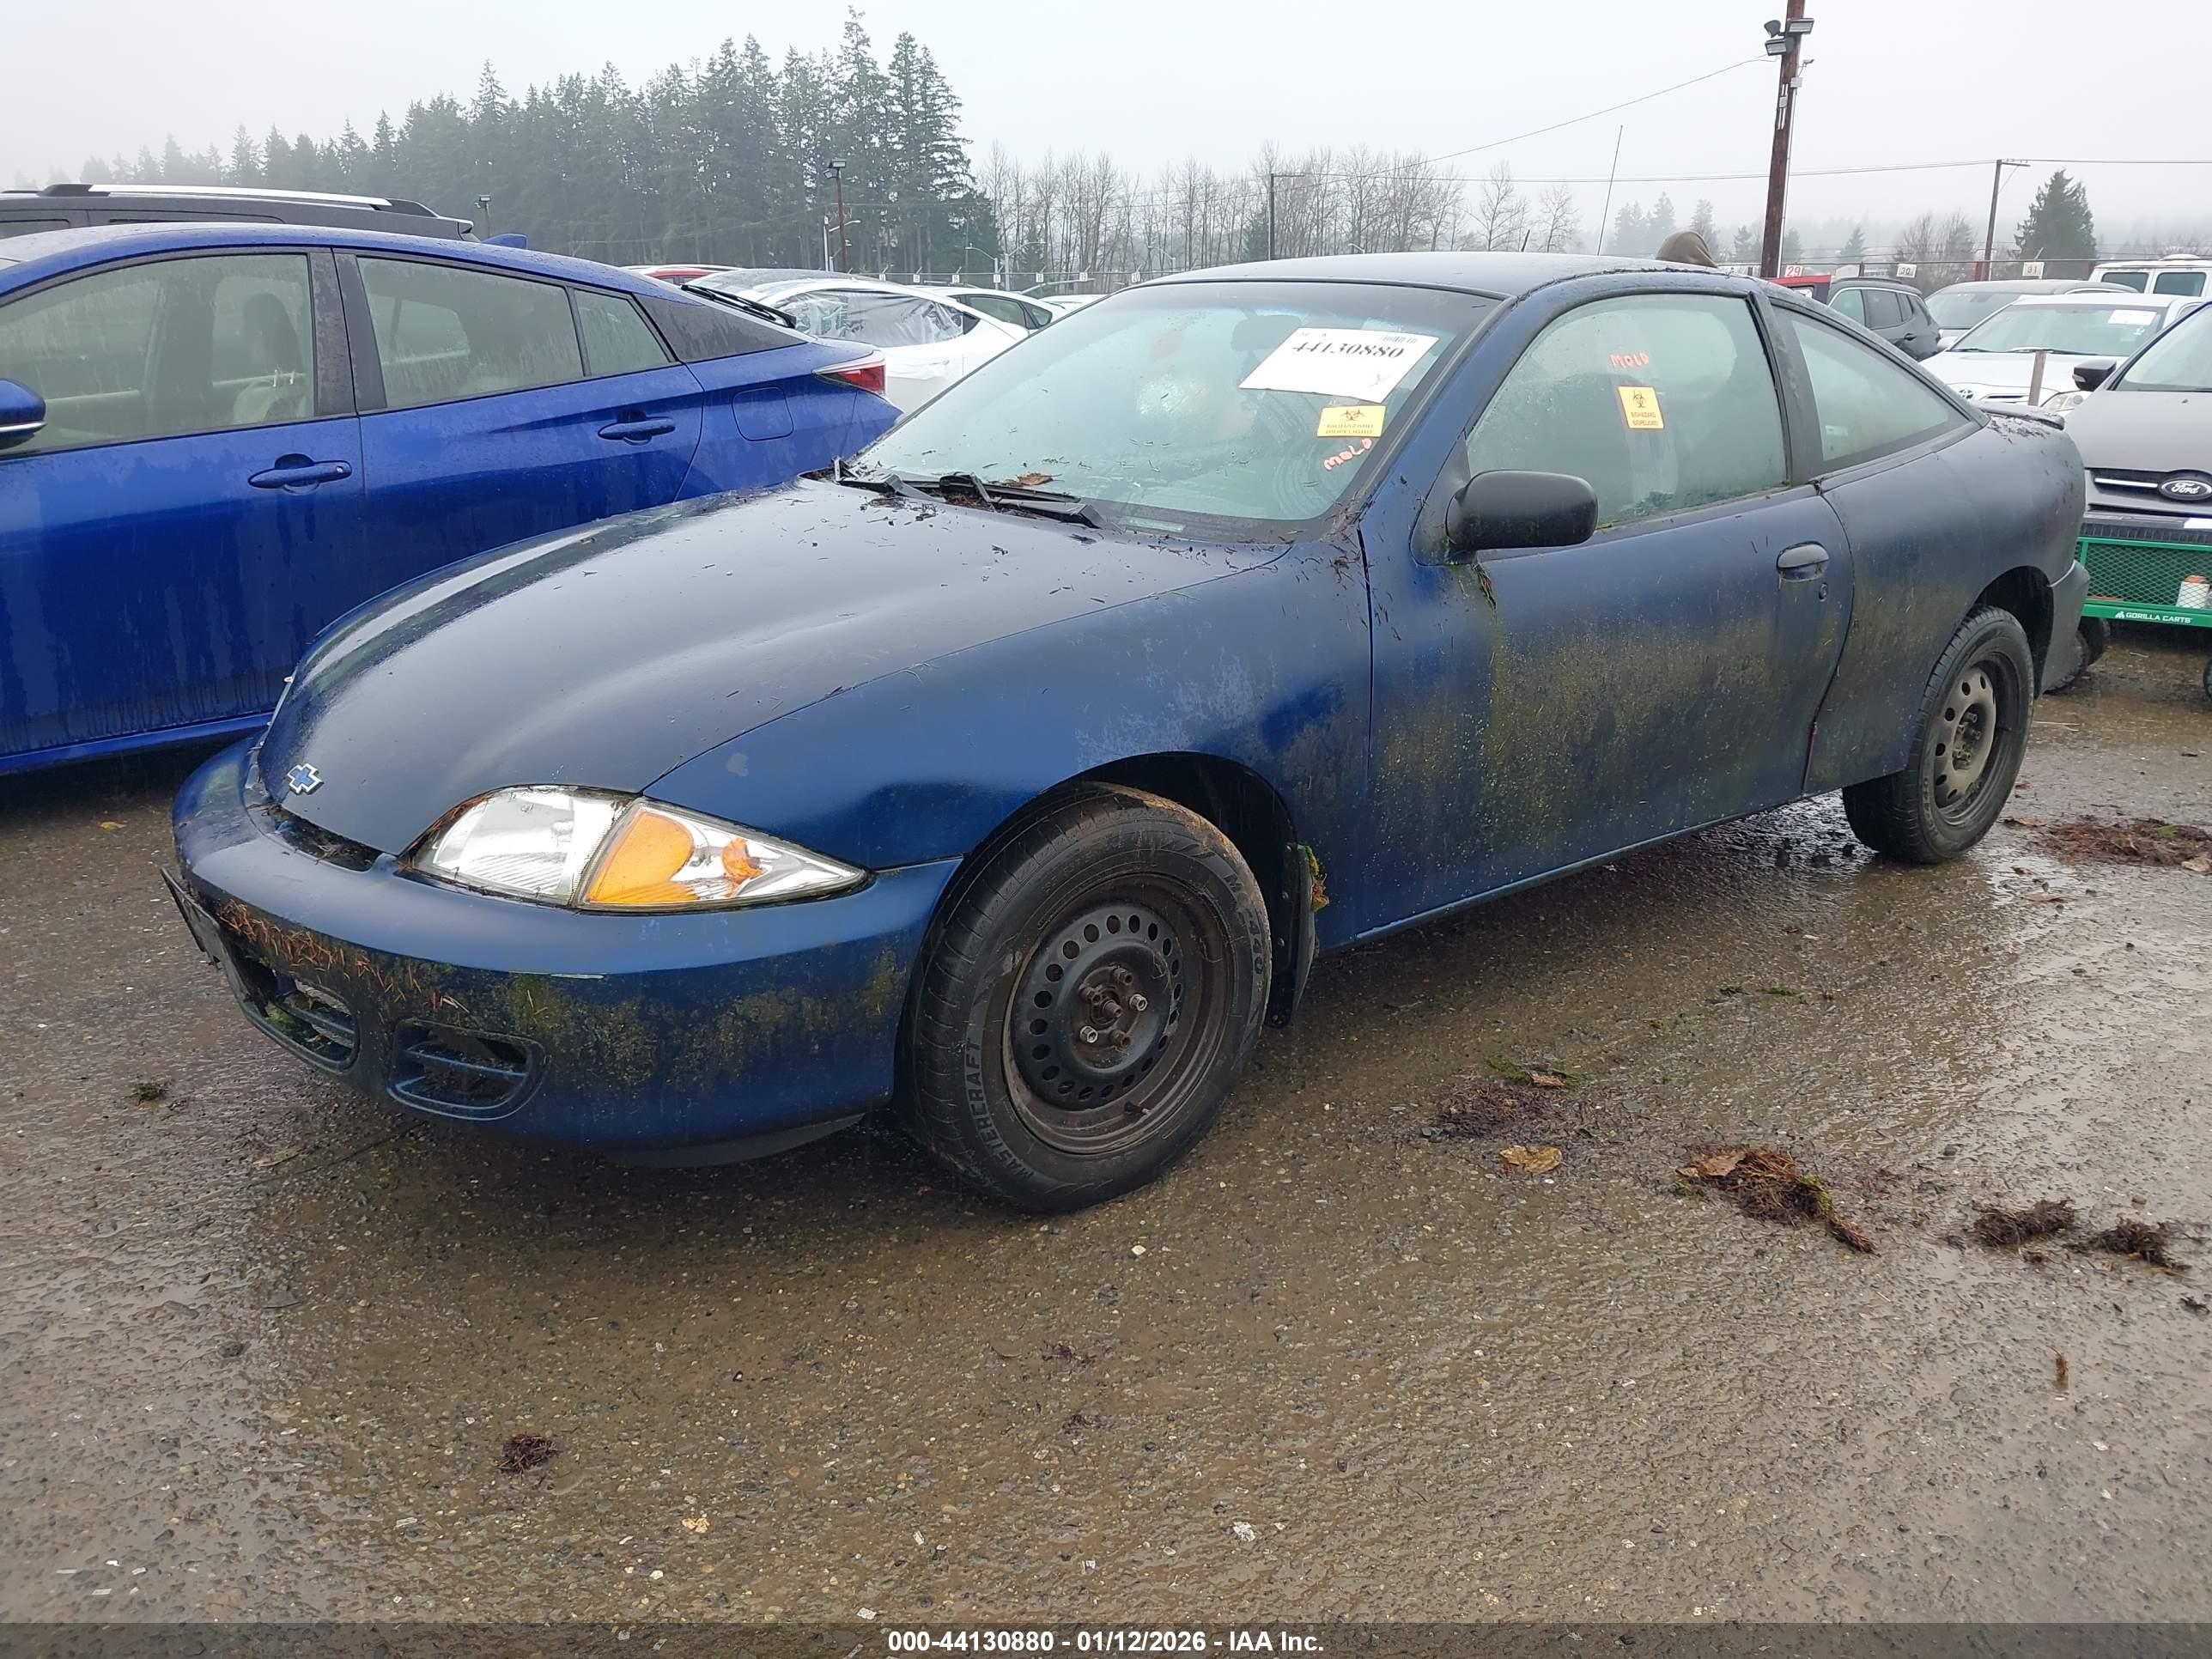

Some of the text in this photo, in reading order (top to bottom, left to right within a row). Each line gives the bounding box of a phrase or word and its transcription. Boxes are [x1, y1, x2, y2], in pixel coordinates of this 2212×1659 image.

[1786, 266, 1801, 276] 29
[1291, 341, 1405, 359] 44130880
[2171, 483, 2200, 495] Ford
[2125, 611, 2192, 623] GORILLA CARTS
[966, 1036, 1035, 1177] MASTERCRAFT
